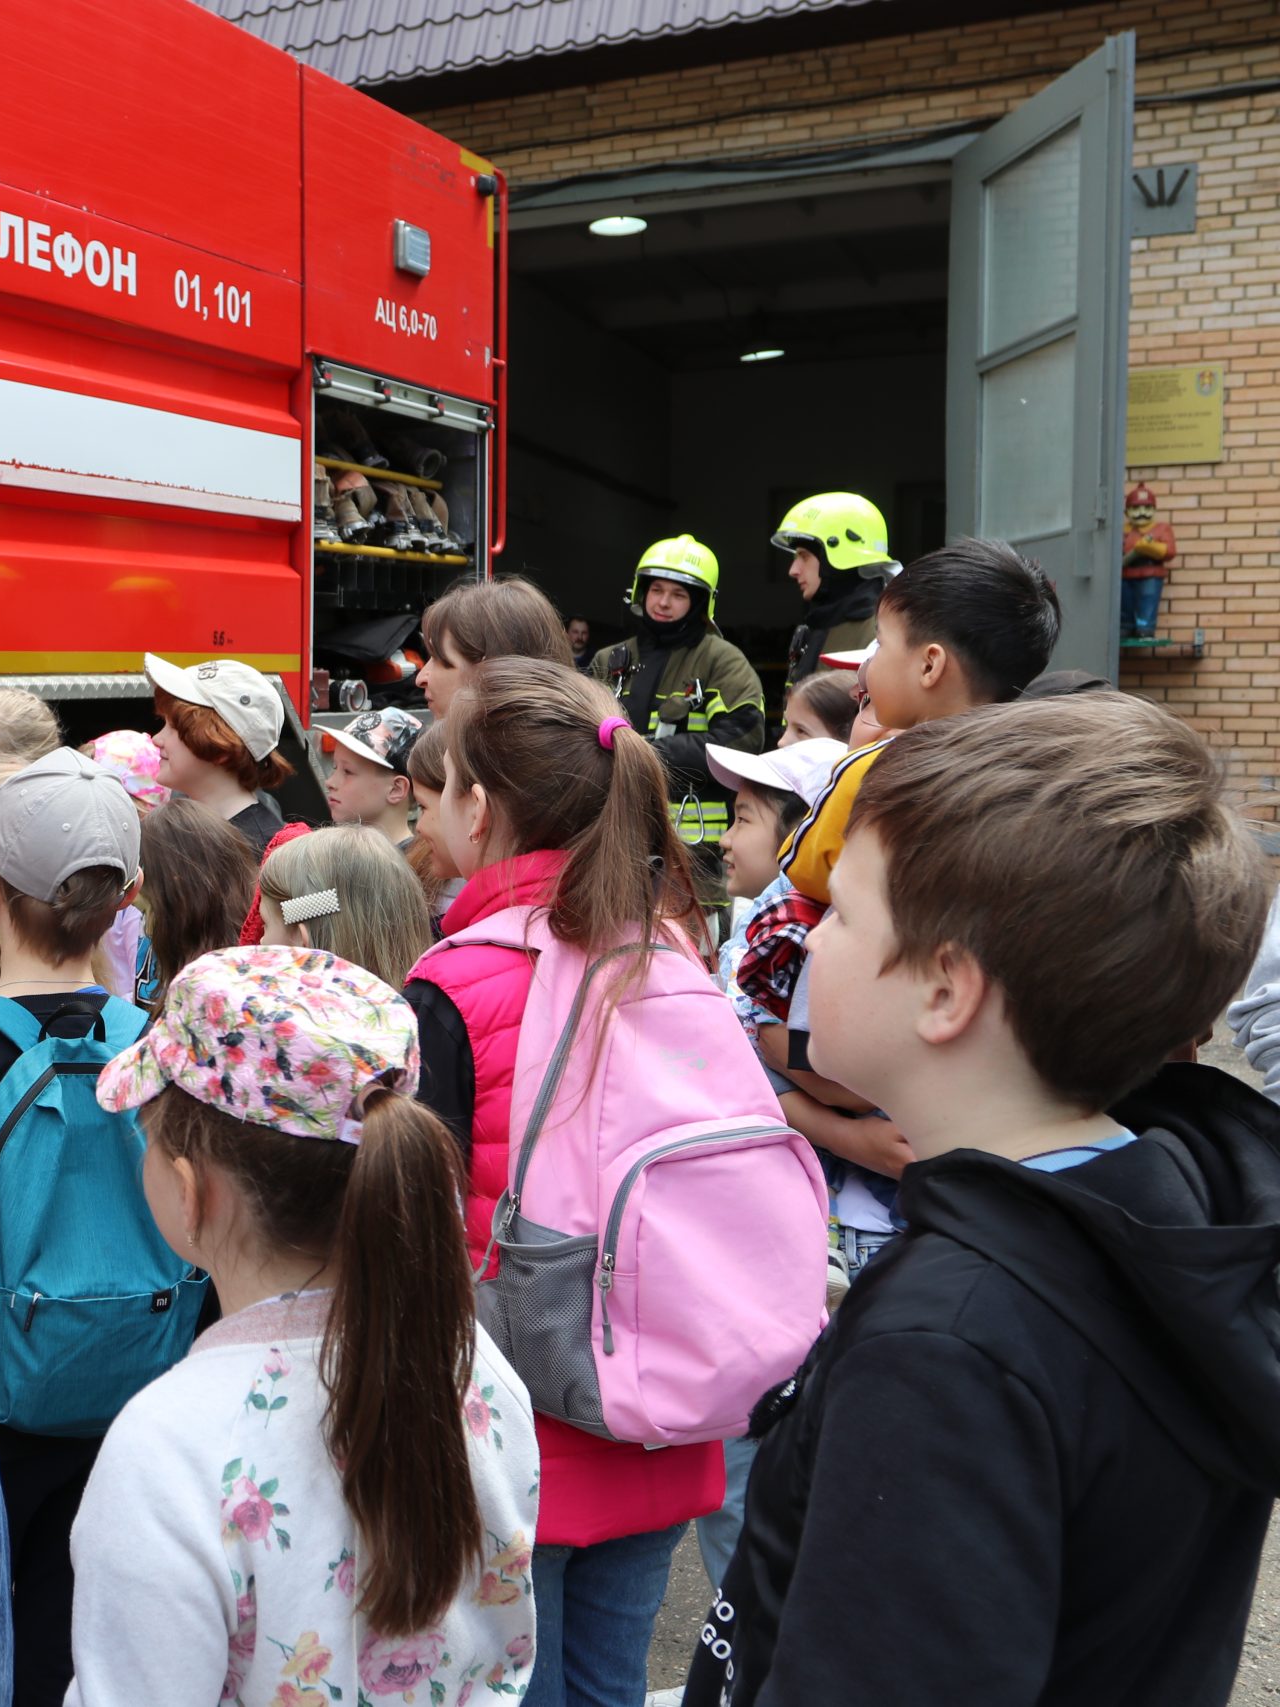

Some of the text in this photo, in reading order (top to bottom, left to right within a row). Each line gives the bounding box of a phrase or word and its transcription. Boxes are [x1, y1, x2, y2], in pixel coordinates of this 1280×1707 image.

[214, 281, 251, 328] 101
[375, 296, 438, 341] АЦ 6,0-70
